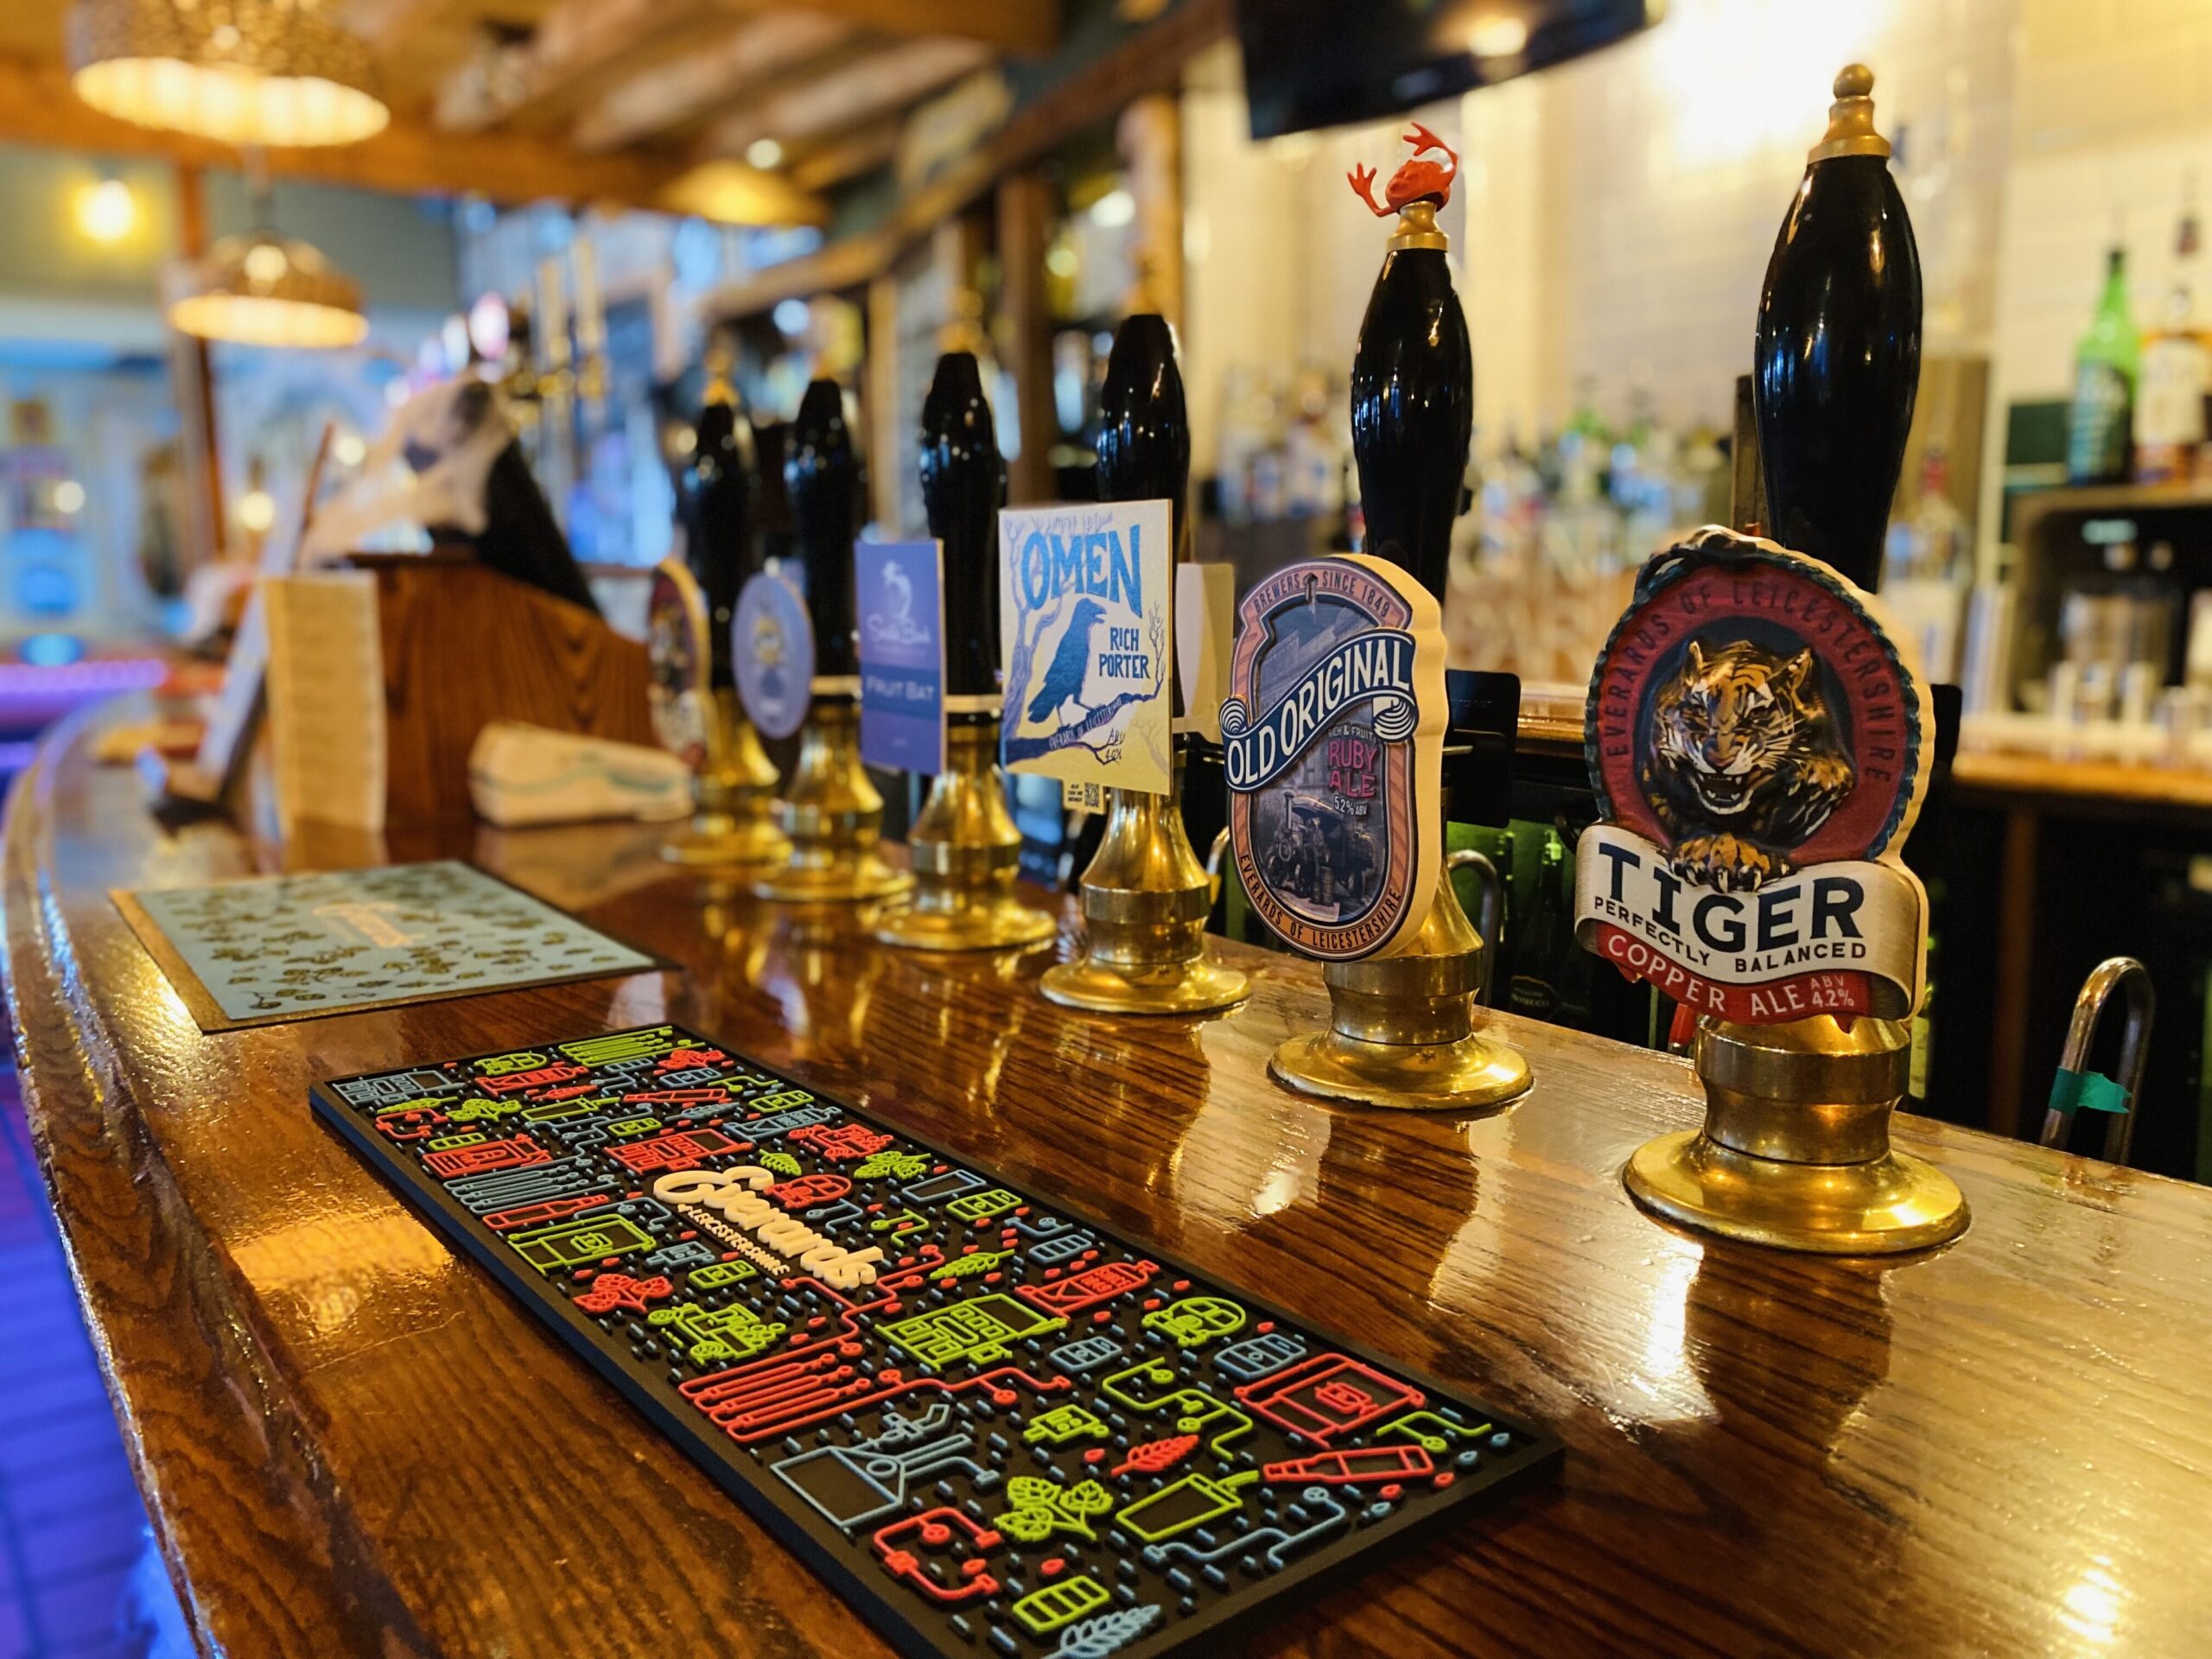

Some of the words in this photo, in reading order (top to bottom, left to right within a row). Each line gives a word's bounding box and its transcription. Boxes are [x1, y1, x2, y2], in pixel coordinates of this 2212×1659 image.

[1021, 524, 1142, 619] OMEN
[1253, 574, 1300, 613] BREWERS
[1322, 571, 1356, 594] SINCE
[1361, 584, 1390, 618] 1849
[1110, 627, 1139, 652] RICH
[1099, 653, 1151, 679] PORTER
[1605, 614, 1670, 759] EVERARDS
[1681, 586, 1713, 614] OF
[1731, 579, 1895, 783] LEICESTERSHIRE
[1227, 725, 1276, 785] OLD
[1281, 640, 1409, 757] ORIGINAL
[1328, 727, 1342, 738] RICH
[1351, 727, 1376, 744] FRUIT
[1328, 739, 1378, 772] RUBY
[1329, 769, 1376, 798] ALE
[1334, 796, 1354, 816] 5.2%
[1355, 804, 1368, 817] ABV
[1239, 855, 1283, 925] EVERARDS
[1290, 925, 1303, 941] OF
[1313, 887, 1402, 950] LEICESTERSHIRE
[1599, 842, 1865, 953] TIGER
[1594, 898, 1711, 967] PERFECTLY
[1735, 942, 1866, 973] BALANCED
[1608, 934, 1726, 1013] COPPER
[1751, 984, 1806, 1017] ALE
[1810, 976, 1846, 989] ABV
[1812, 988, 1855, 1008] 4.2%
